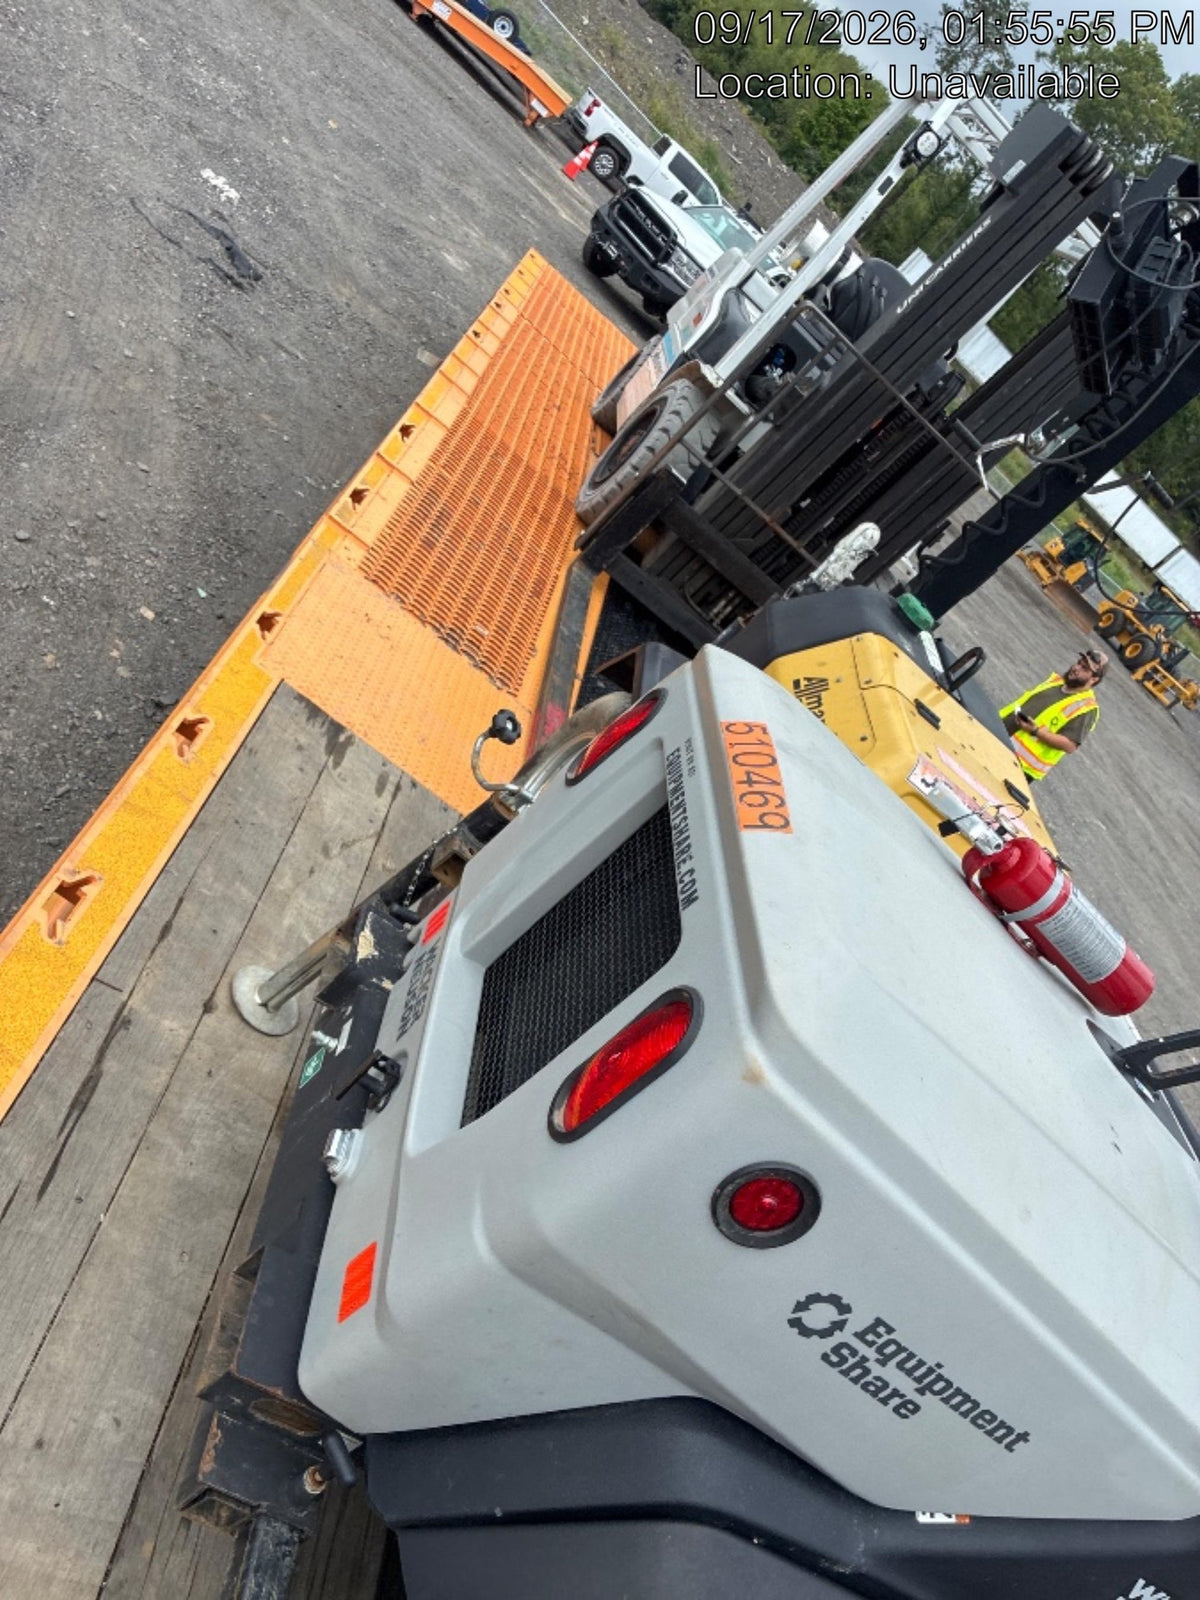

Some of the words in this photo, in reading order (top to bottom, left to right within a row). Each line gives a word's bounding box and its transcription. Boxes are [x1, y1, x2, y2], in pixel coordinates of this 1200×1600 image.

[665, 747, 700, 912] EQUIPMENTSHARE.COM
[724, 722, 791, 831] 510469
[820, 1341, 922, 1420] Share
[852, 1316, 1031, 1454] Equipment
